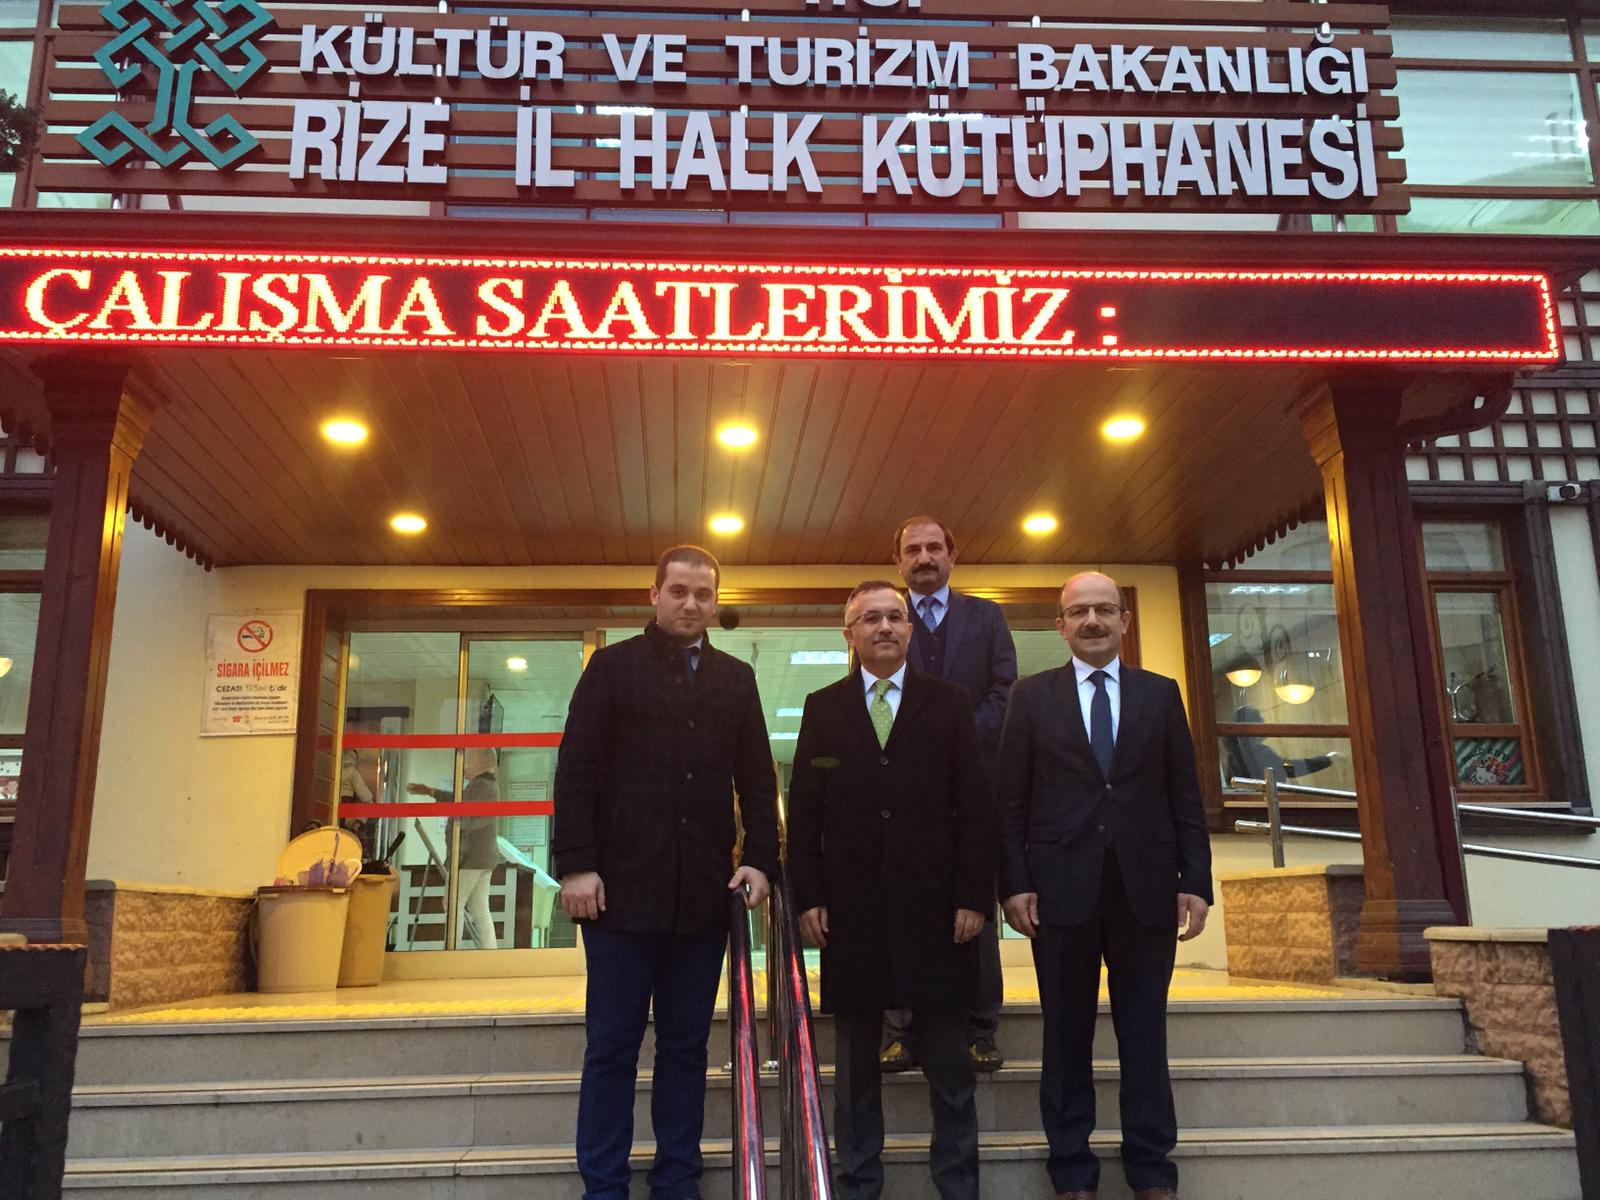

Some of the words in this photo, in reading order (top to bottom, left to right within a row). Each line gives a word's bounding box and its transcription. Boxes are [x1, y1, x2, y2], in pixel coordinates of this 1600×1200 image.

[300, 12, 565, 80] KÜLTÜR
[602, 33, 687, 82] VE
[725, 26, 969, 88] TURİZM
[1017, 22, 1369, 95] BAKANLIĞI
[289, 81, 450, 183] RİZE
[515, 85, 575, 188] İL
[620, 110, 824, 193] HALK
[862, 94, 1378, 200] KÜTÜPHANESİ
[217, 659, 249, 678] SİGARA
[252, 658, 289, 681] İÇİLMEZ
